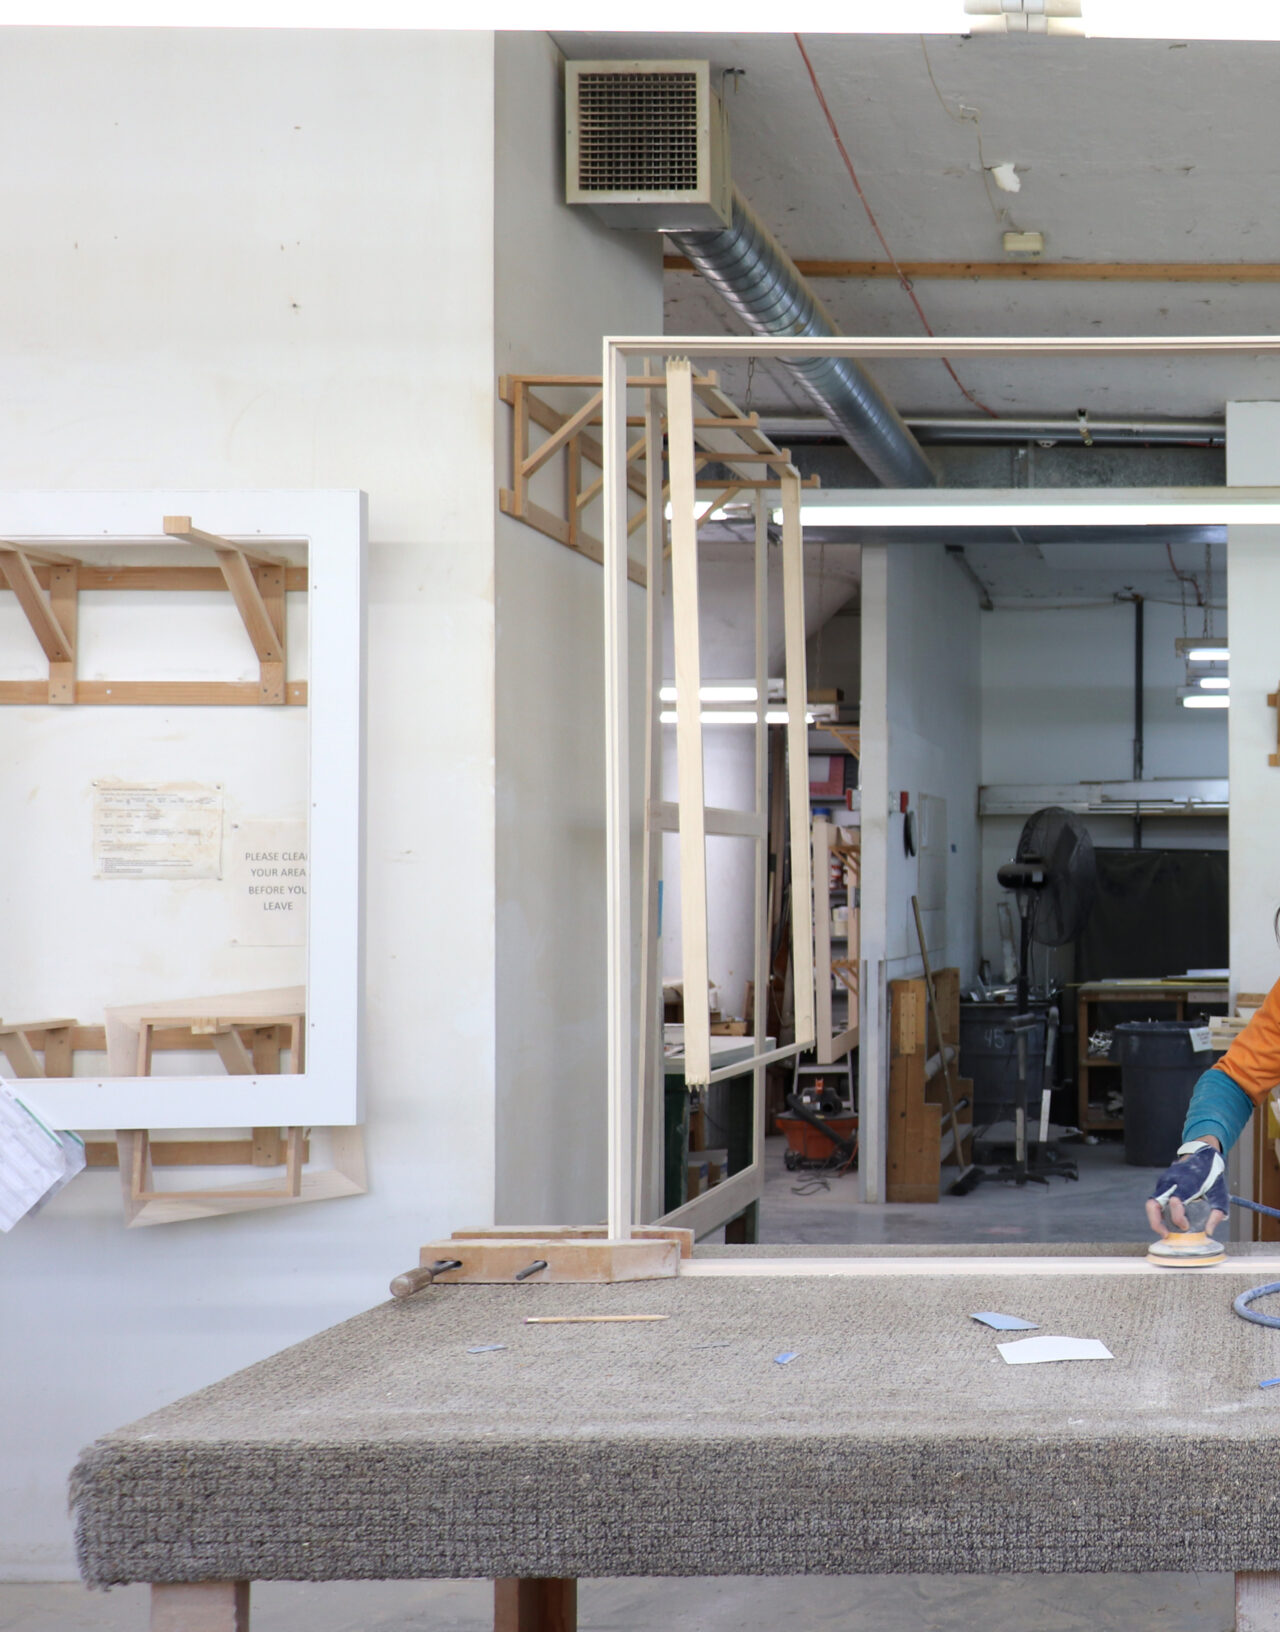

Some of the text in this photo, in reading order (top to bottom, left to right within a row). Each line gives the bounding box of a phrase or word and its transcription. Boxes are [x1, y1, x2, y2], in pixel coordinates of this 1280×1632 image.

[245, 852, 308, 861] PLEASE CLEA
[251, 868, 306, 877] YOUR AREA
[248, 886, 285, 895] BEFORE
[263, 902, 293, 911] LEAVE
[984, 1029, 1005, 1048] 45
